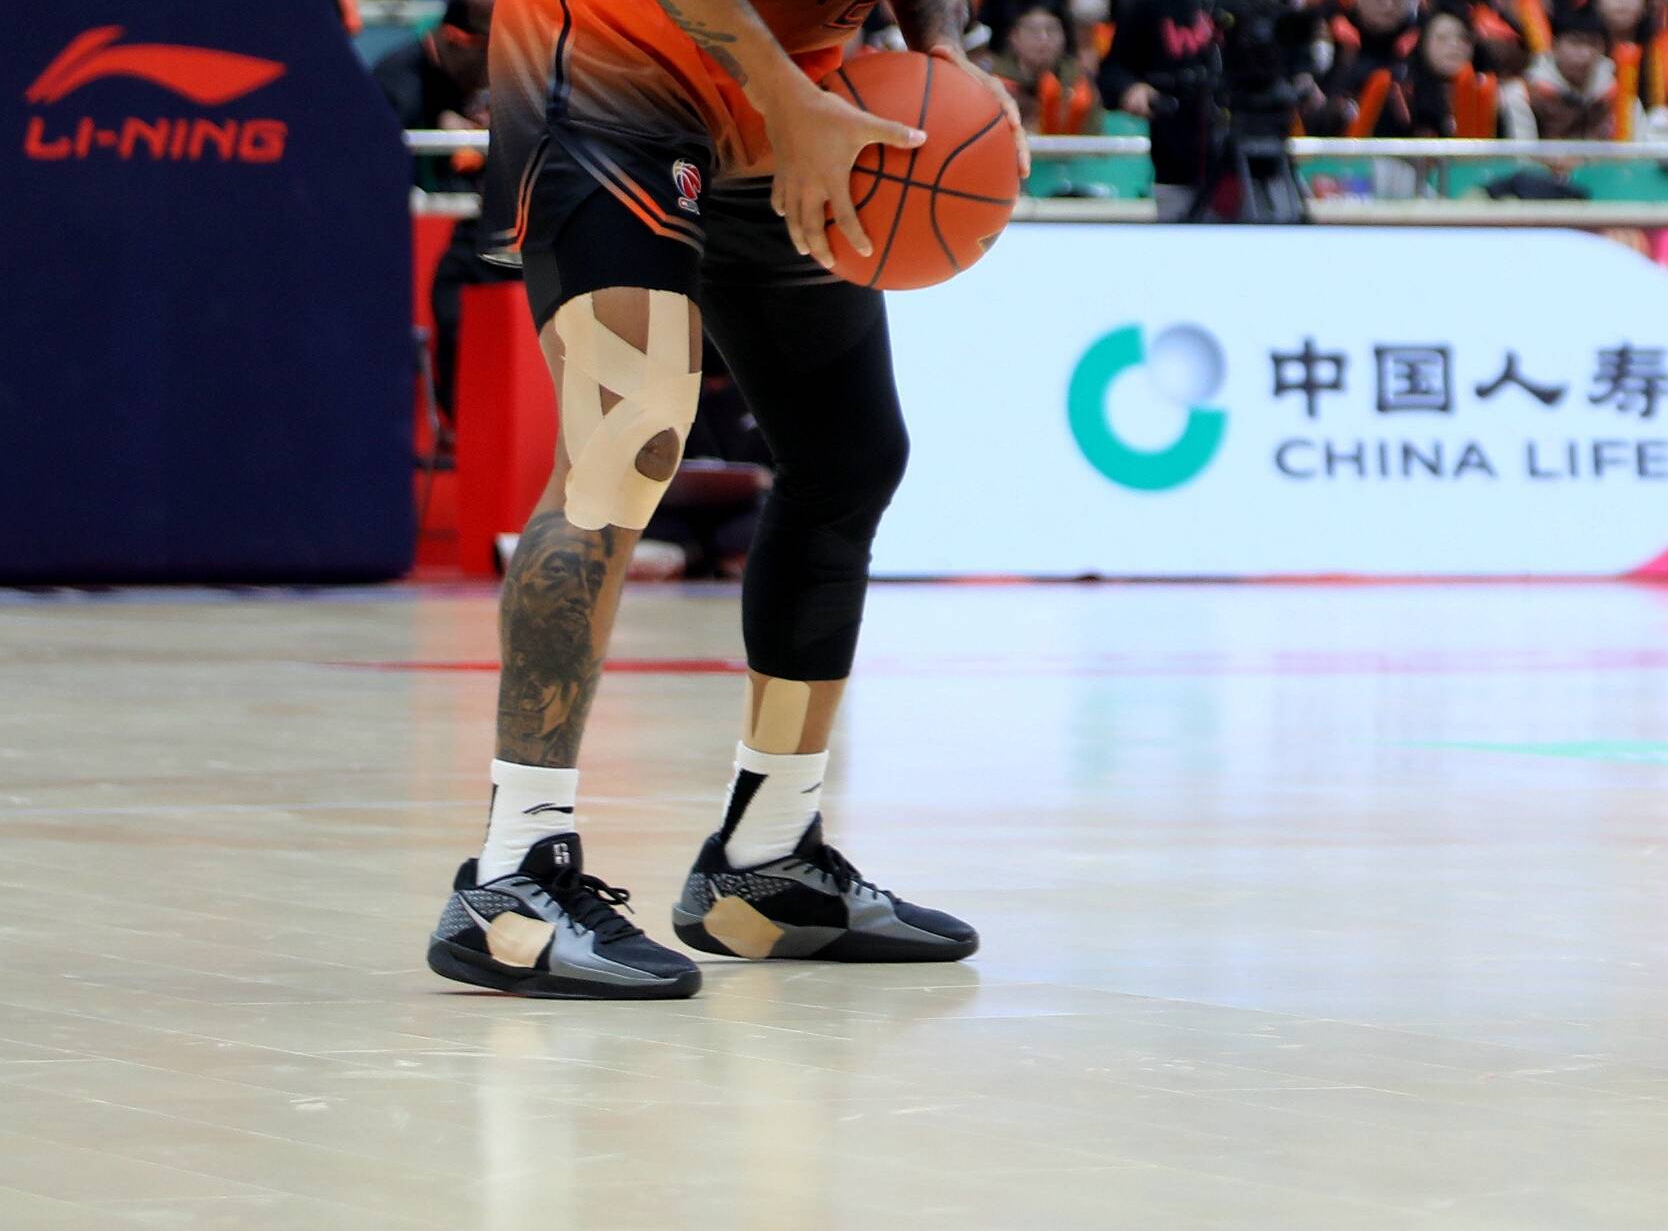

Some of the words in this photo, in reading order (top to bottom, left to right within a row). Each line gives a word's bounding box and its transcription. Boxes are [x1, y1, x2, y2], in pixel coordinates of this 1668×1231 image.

[24, 117, 288, 162] LI-NING
[1270, 336, 1668, 419] 中国人寿
[1274, 438, 1496, 480] CHINA
[1527, 438, 1668, 480] LIFE
